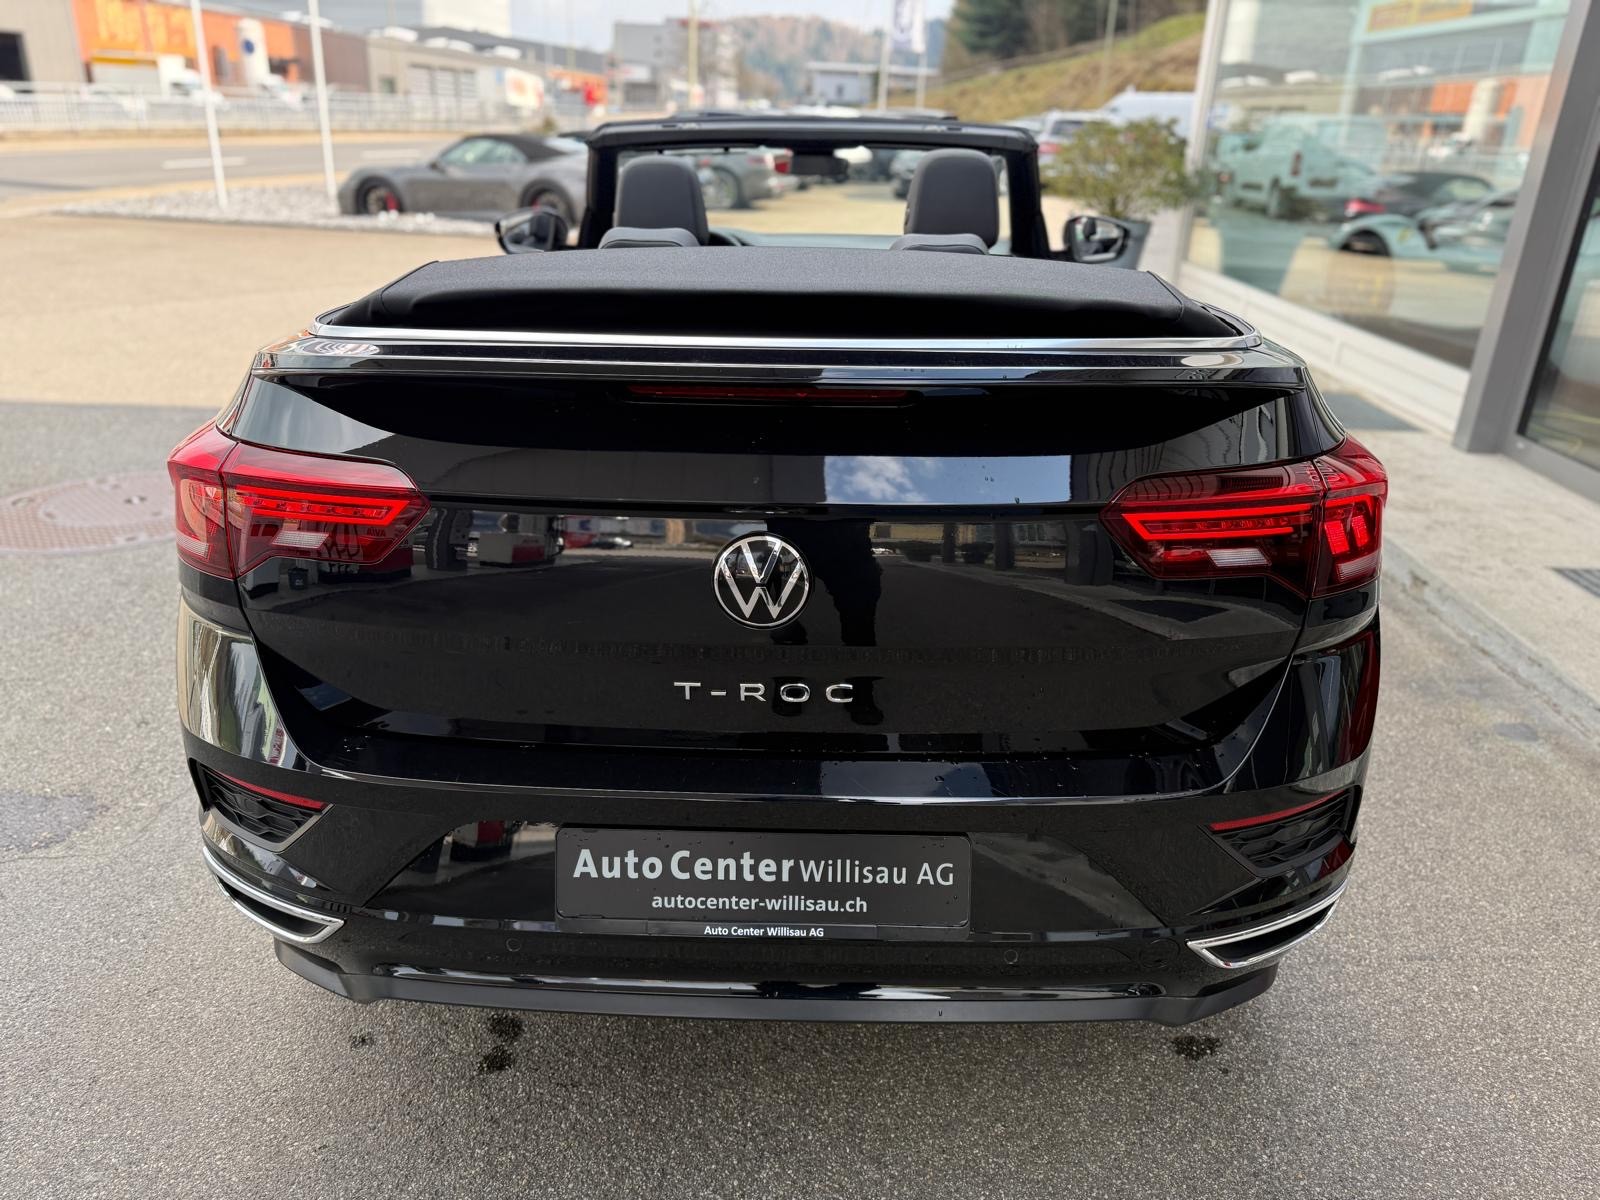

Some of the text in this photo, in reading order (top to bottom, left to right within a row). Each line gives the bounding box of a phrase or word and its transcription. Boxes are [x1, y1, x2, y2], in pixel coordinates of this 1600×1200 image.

[715, 536, 809, 626] VW
[673, 681, 853, 703] T-ROC
[573, 848, 954, 886] Auto Center Willisau AG
[651, 893, 868, 913] autocenter-willisau.ch
[703, 925, 825, 938] Auto Center Willisau AG
